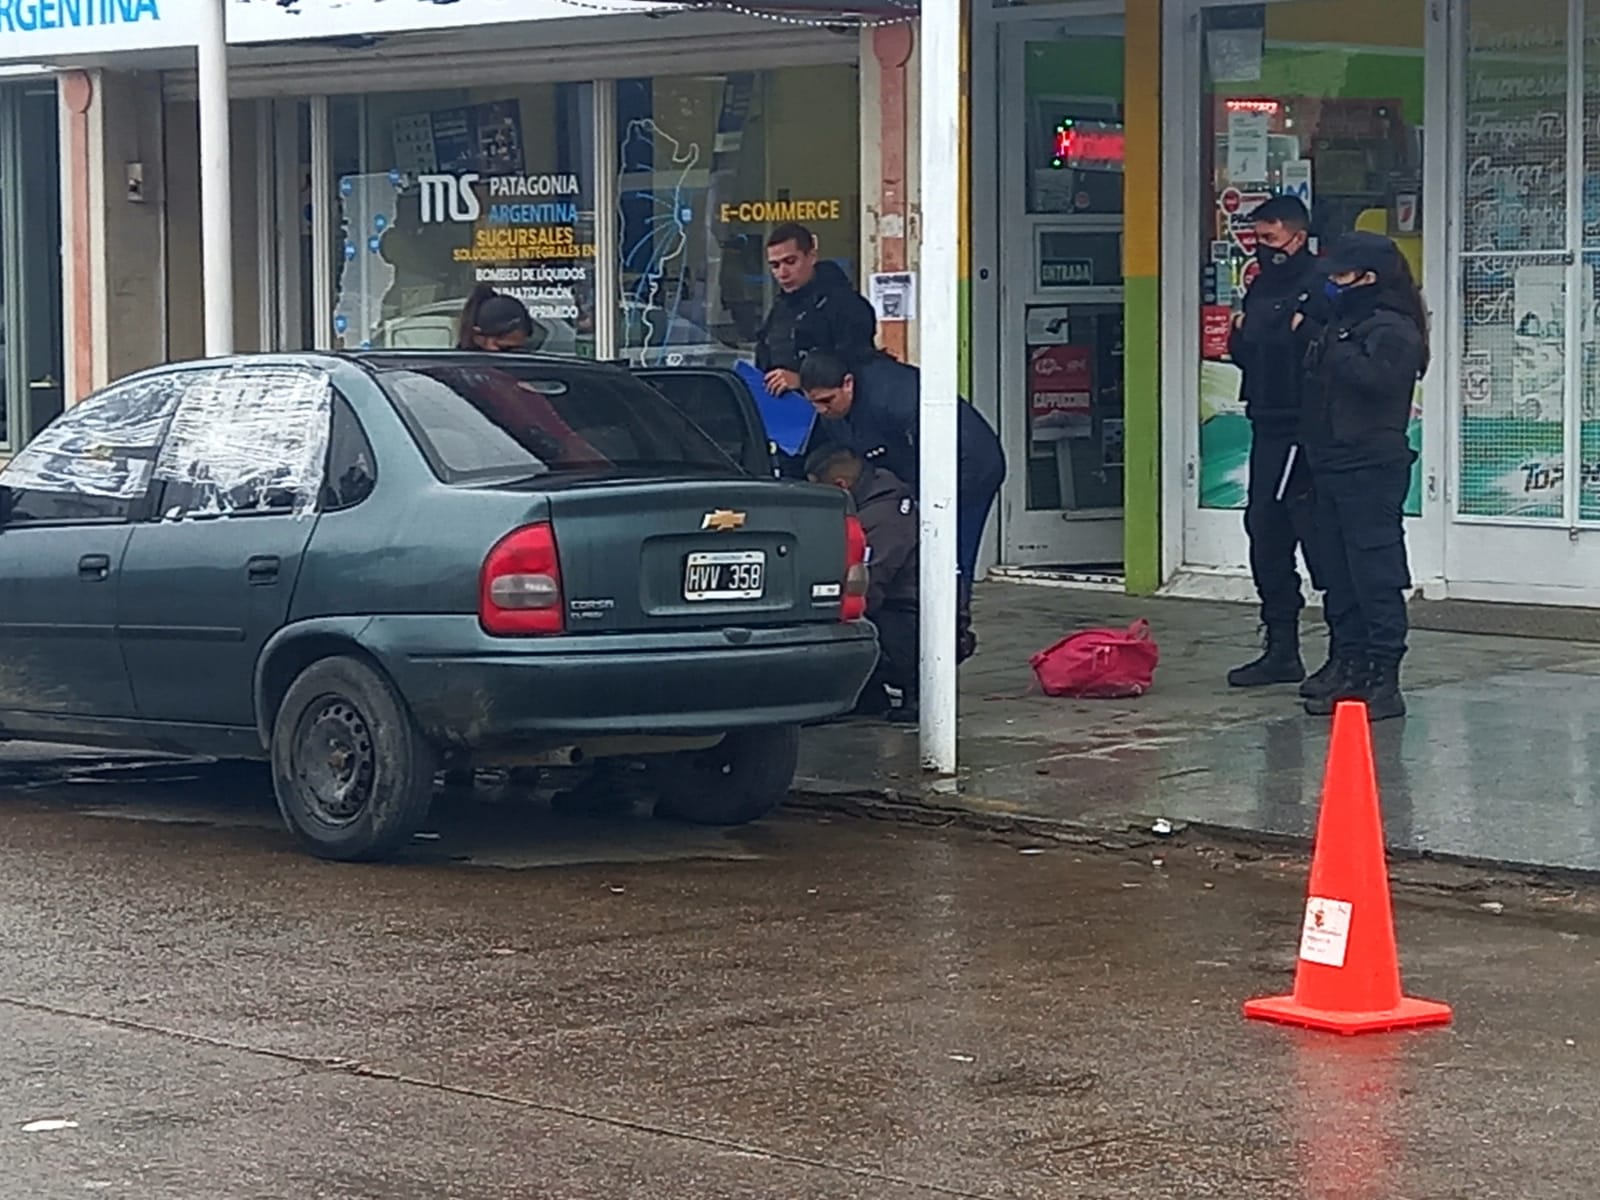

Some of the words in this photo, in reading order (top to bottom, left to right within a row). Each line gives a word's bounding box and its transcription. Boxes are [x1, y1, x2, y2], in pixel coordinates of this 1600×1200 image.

[489, 174, 579, 197] PATAGONIA
[488, 202, 579, 224] ARGENTINA
[720, 200, 840, 223] E-COMMERCE
[476, 226, 574, 247] SUCURSALES
[453, 247, 517, 261] SOLUCIONES
[518, 244, 580, 260] INTEGRALES
[475, 268, 520, 282] BOMBEO
[521, 268, 536, 281] DE
[537, 265, 587, 282] LÍQUIDOS
[1042, 264, 1090, 281] ENTRADA
[688, 565, 720, 590] HVV
[728, 564, 761, 589] 358
